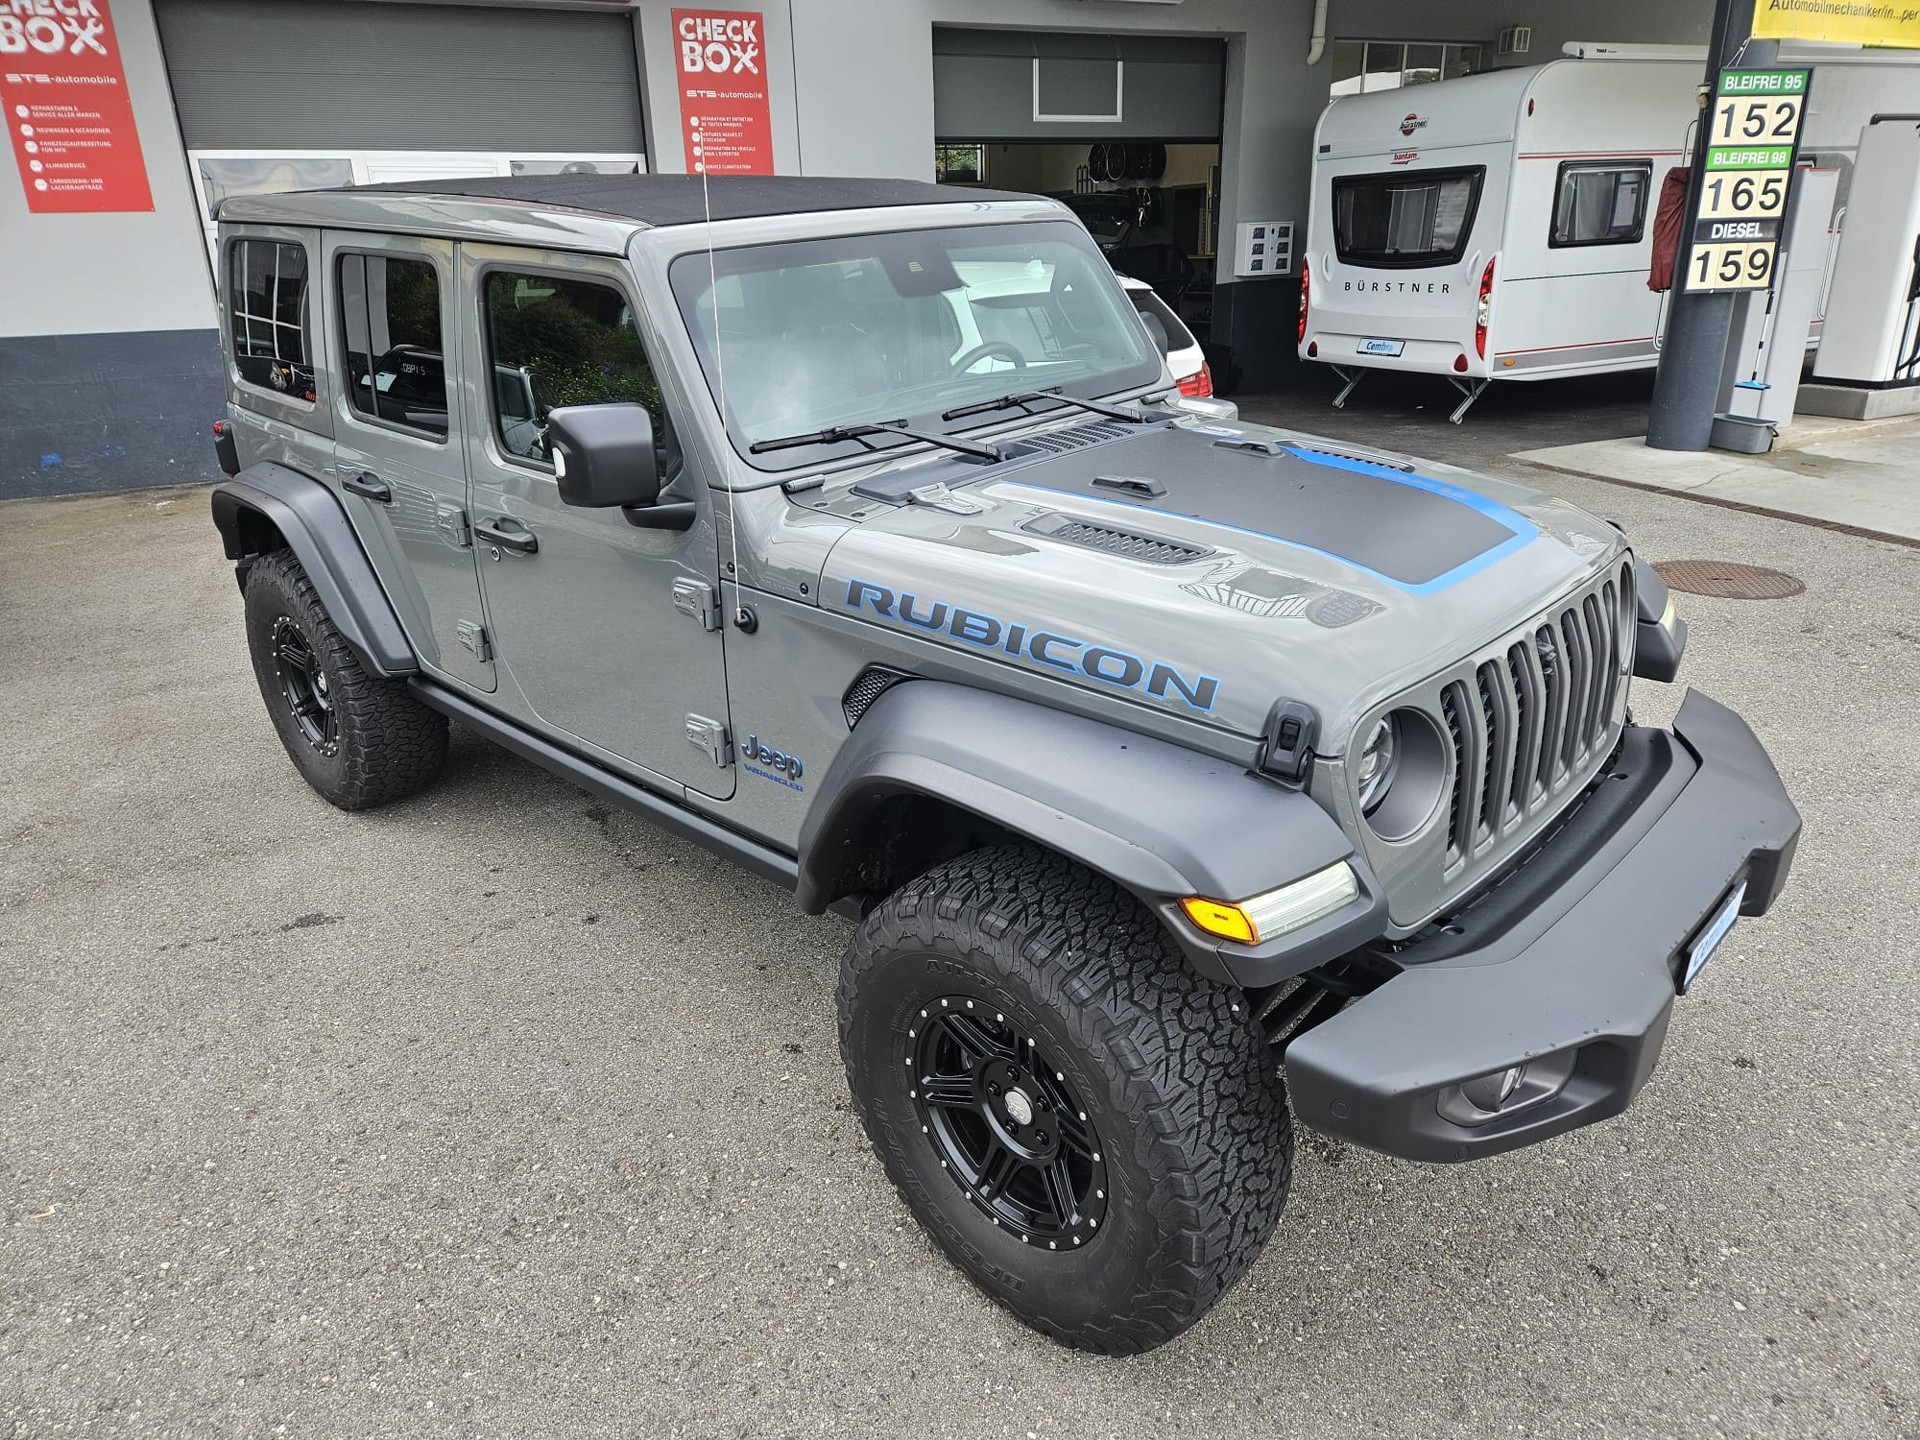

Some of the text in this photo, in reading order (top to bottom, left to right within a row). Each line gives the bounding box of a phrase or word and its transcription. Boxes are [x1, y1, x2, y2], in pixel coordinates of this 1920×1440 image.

[0, 0, 101, 17] HECK
[679, 17, 758, 43] CHECK
[682, 41, 759, 74] BOX
[1724, 75, 1803, 90] BLEIFREI 95
[1721, 102, 1796, 138] 152
[1713, 151, 1786, 166] BLEIFREI 98
[1708, 177, 1783, 211] 165
[1711, 222, 1763, 239] DIESEL
[1696, 248, 1770, 283] 159
[1344, 280, 1450, 294] BÜRSTNER
[1366, 341, 1394, 352] Cembra
[846, 577, 1221, 713] RUBICON
[741, 733, 803, 781] Jeep
